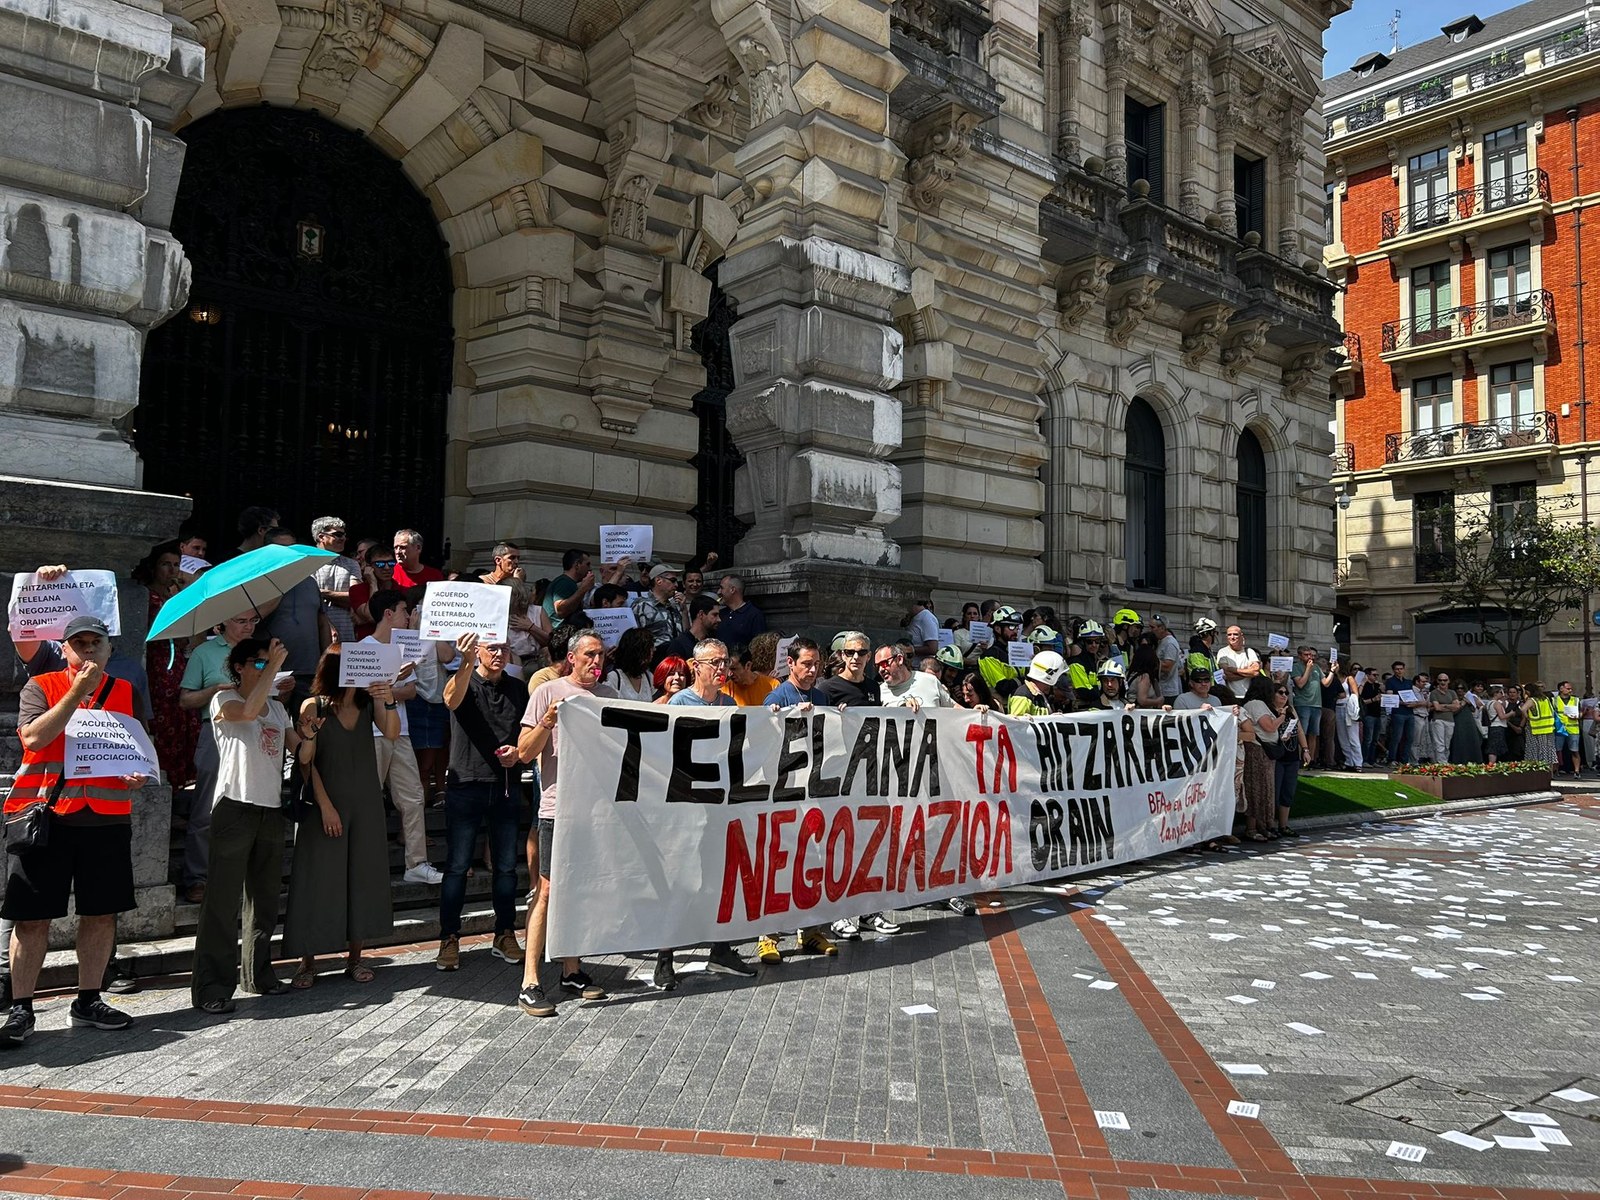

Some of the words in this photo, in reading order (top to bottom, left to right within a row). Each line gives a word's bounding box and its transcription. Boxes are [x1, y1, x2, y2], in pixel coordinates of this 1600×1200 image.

[17, 582, 78, 592] "HITZARMENA
[17, 594, 61, 603] TELELANA
[19, 605, 78, 615] NEGOZIAZIOA
[430, 610, 475, 618] TELETRABAJO
[429, 620, 478, 628] NEGOCIACION
[1454, 632, 1495, 645] TOUS
[77, 731, 125, 739] CONVENIO
[601, 707, 940, 804] TELELANA
[965, 723, 1018, 794] TA
[1029, 714, 1219, 793] HITZARMENA
[716, 800, 1013, 924] NEGOZIAZIOA
[1029, 795, 1115, 872] ORAIN
